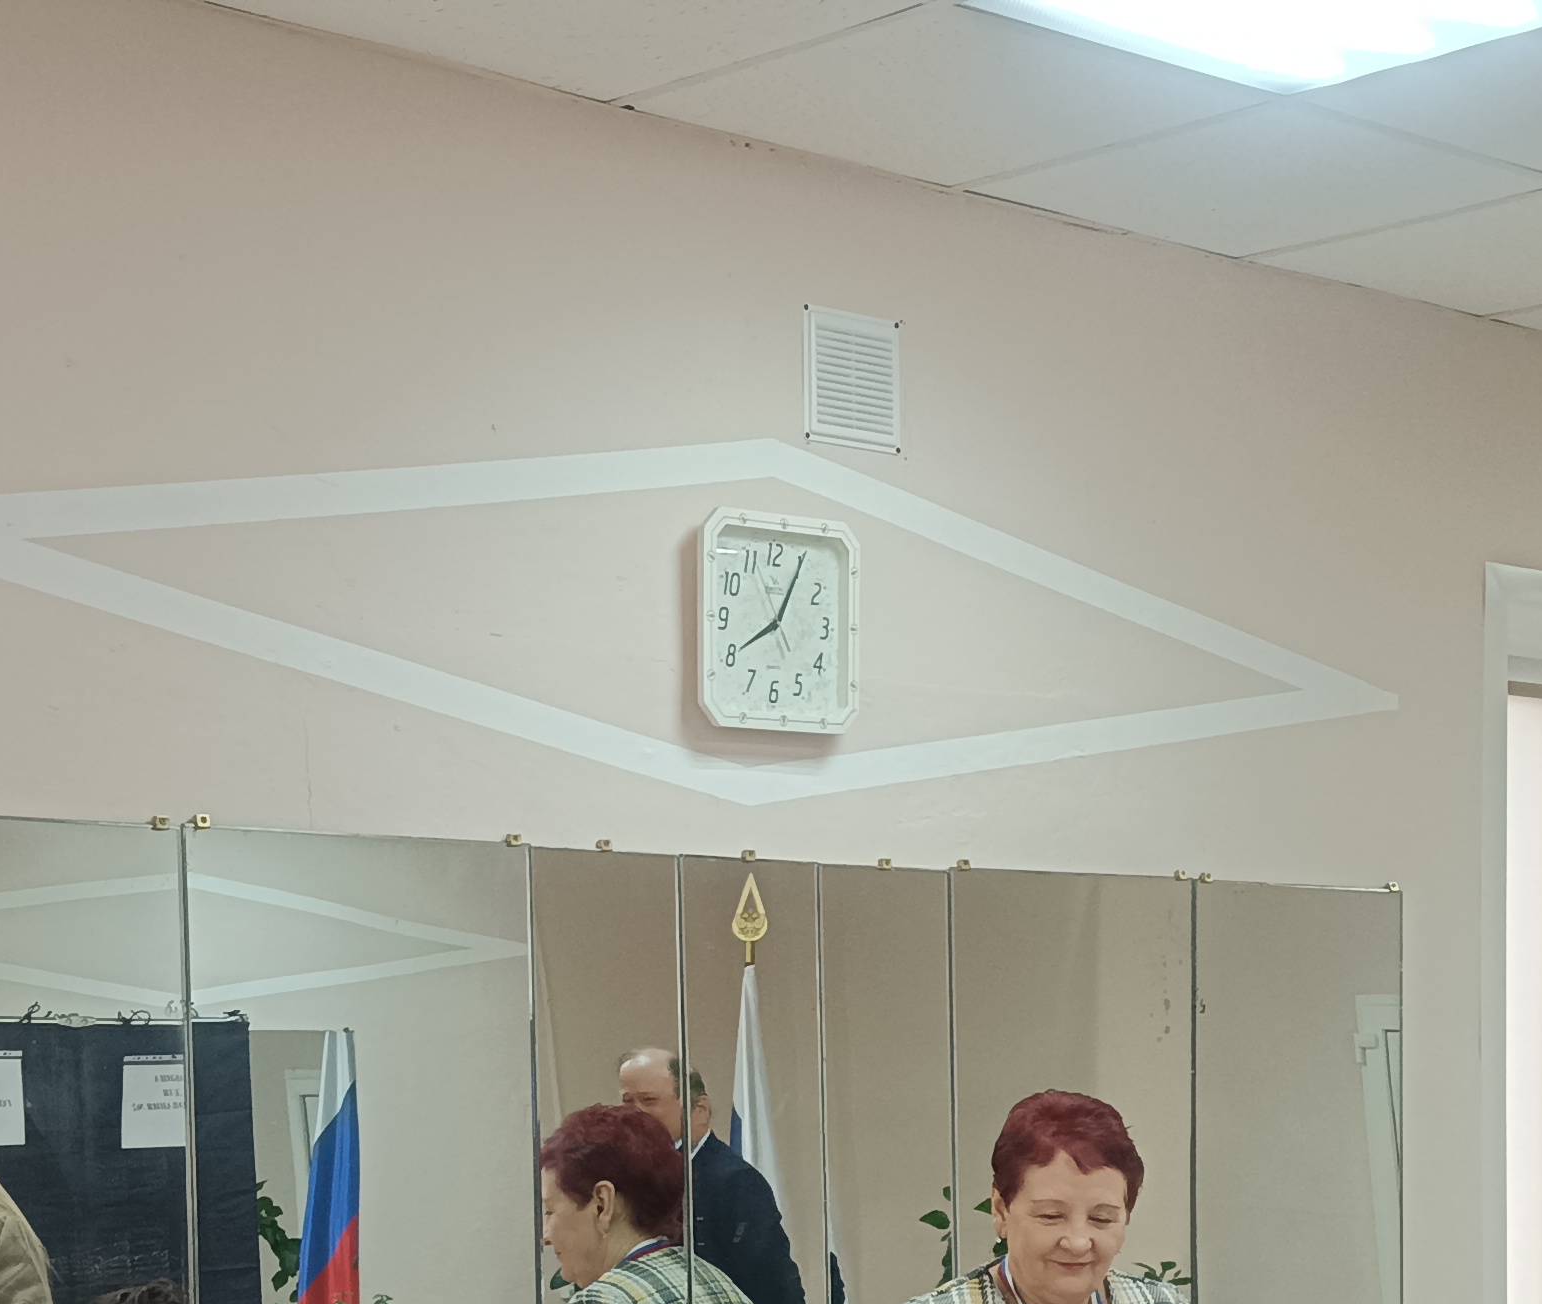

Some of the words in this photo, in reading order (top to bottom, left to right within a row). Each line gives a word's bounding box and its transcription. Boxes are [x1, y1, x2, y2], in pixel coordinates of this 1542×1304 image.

[744, 549, 758, 574] 11
[767, 542, 784, 567] 12
[723, 571, 741, 596] 10
[810, 582, 822, 606] 2
[717, 606, 730, 630] 9
[819, 617, 830, 640] 3
[725, 643, 737, 667] 8
[812, 652, 824, 676] 4
[746, 668, 757, 692] 7
[768, 680, 780, 703] 6
[792, 672, 803, 696] 5
